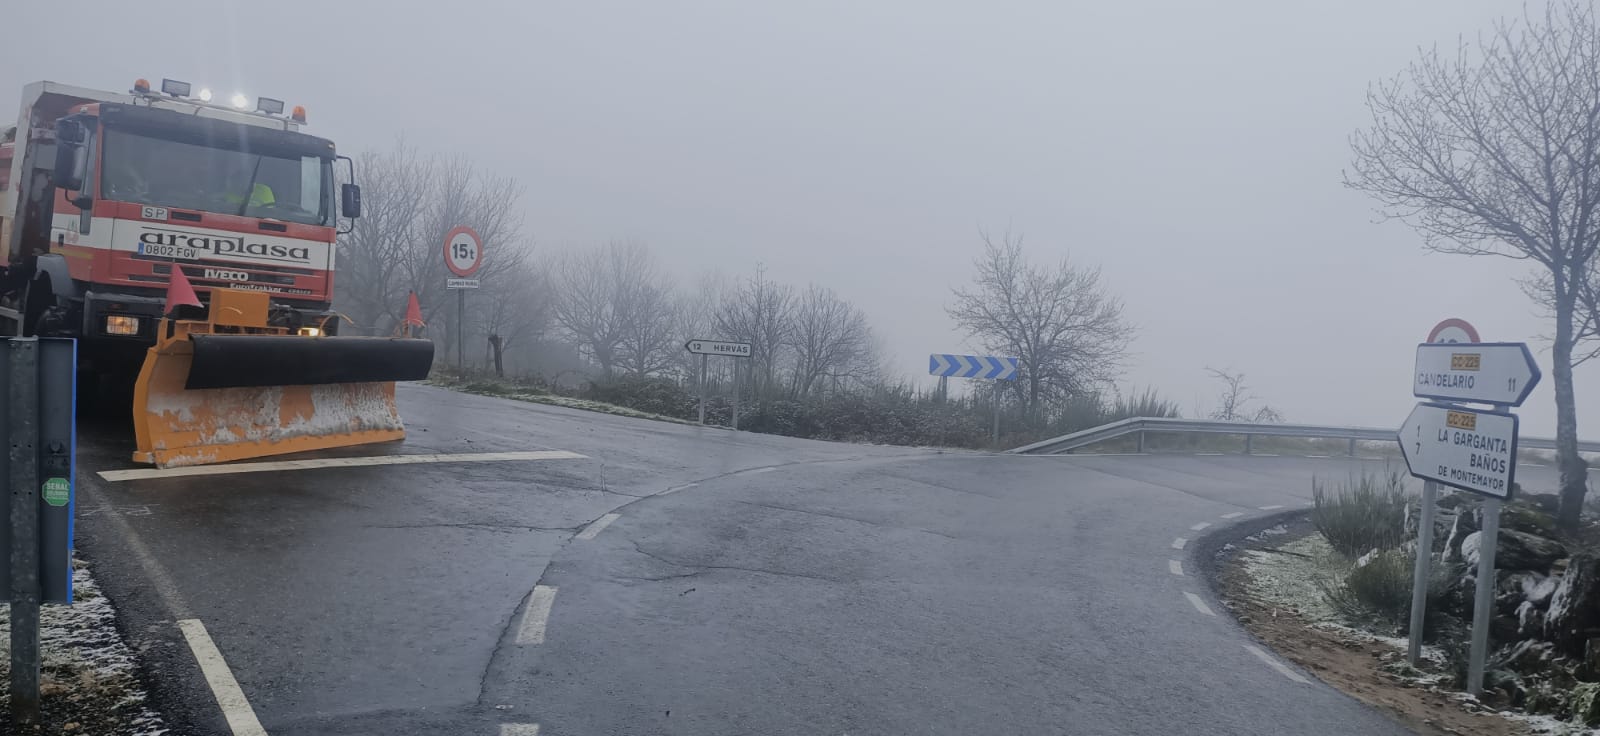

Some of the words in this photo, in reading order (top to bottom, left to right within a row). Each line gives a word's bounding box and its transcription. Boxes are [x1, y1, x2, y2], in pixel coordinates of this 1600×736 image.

[139, 232, 311, 260] araplasa
[145, 244, 174, 257] 0802
[176, 247, 196, 259] FGV
[204, 268, 249, 282] IVECO
[1452, 356, 1480, 368] CC-225
[1418, 373, 1475, 389] CANDELARIO
[1507, 377, 1517, 393] 11
[1447, 412, 1475, 428] CC-225
[1438, 428, 1449, 443] LA
[1454, 431, 1507, 455] GARGANTA
[1415, 442, 1421, 455] 7
[1470, 453, 1506, 474] BAÑOS
[1438, 465, 1447, 477] DE
[1450, 469, 1504, 490] MONTEMAYOR
